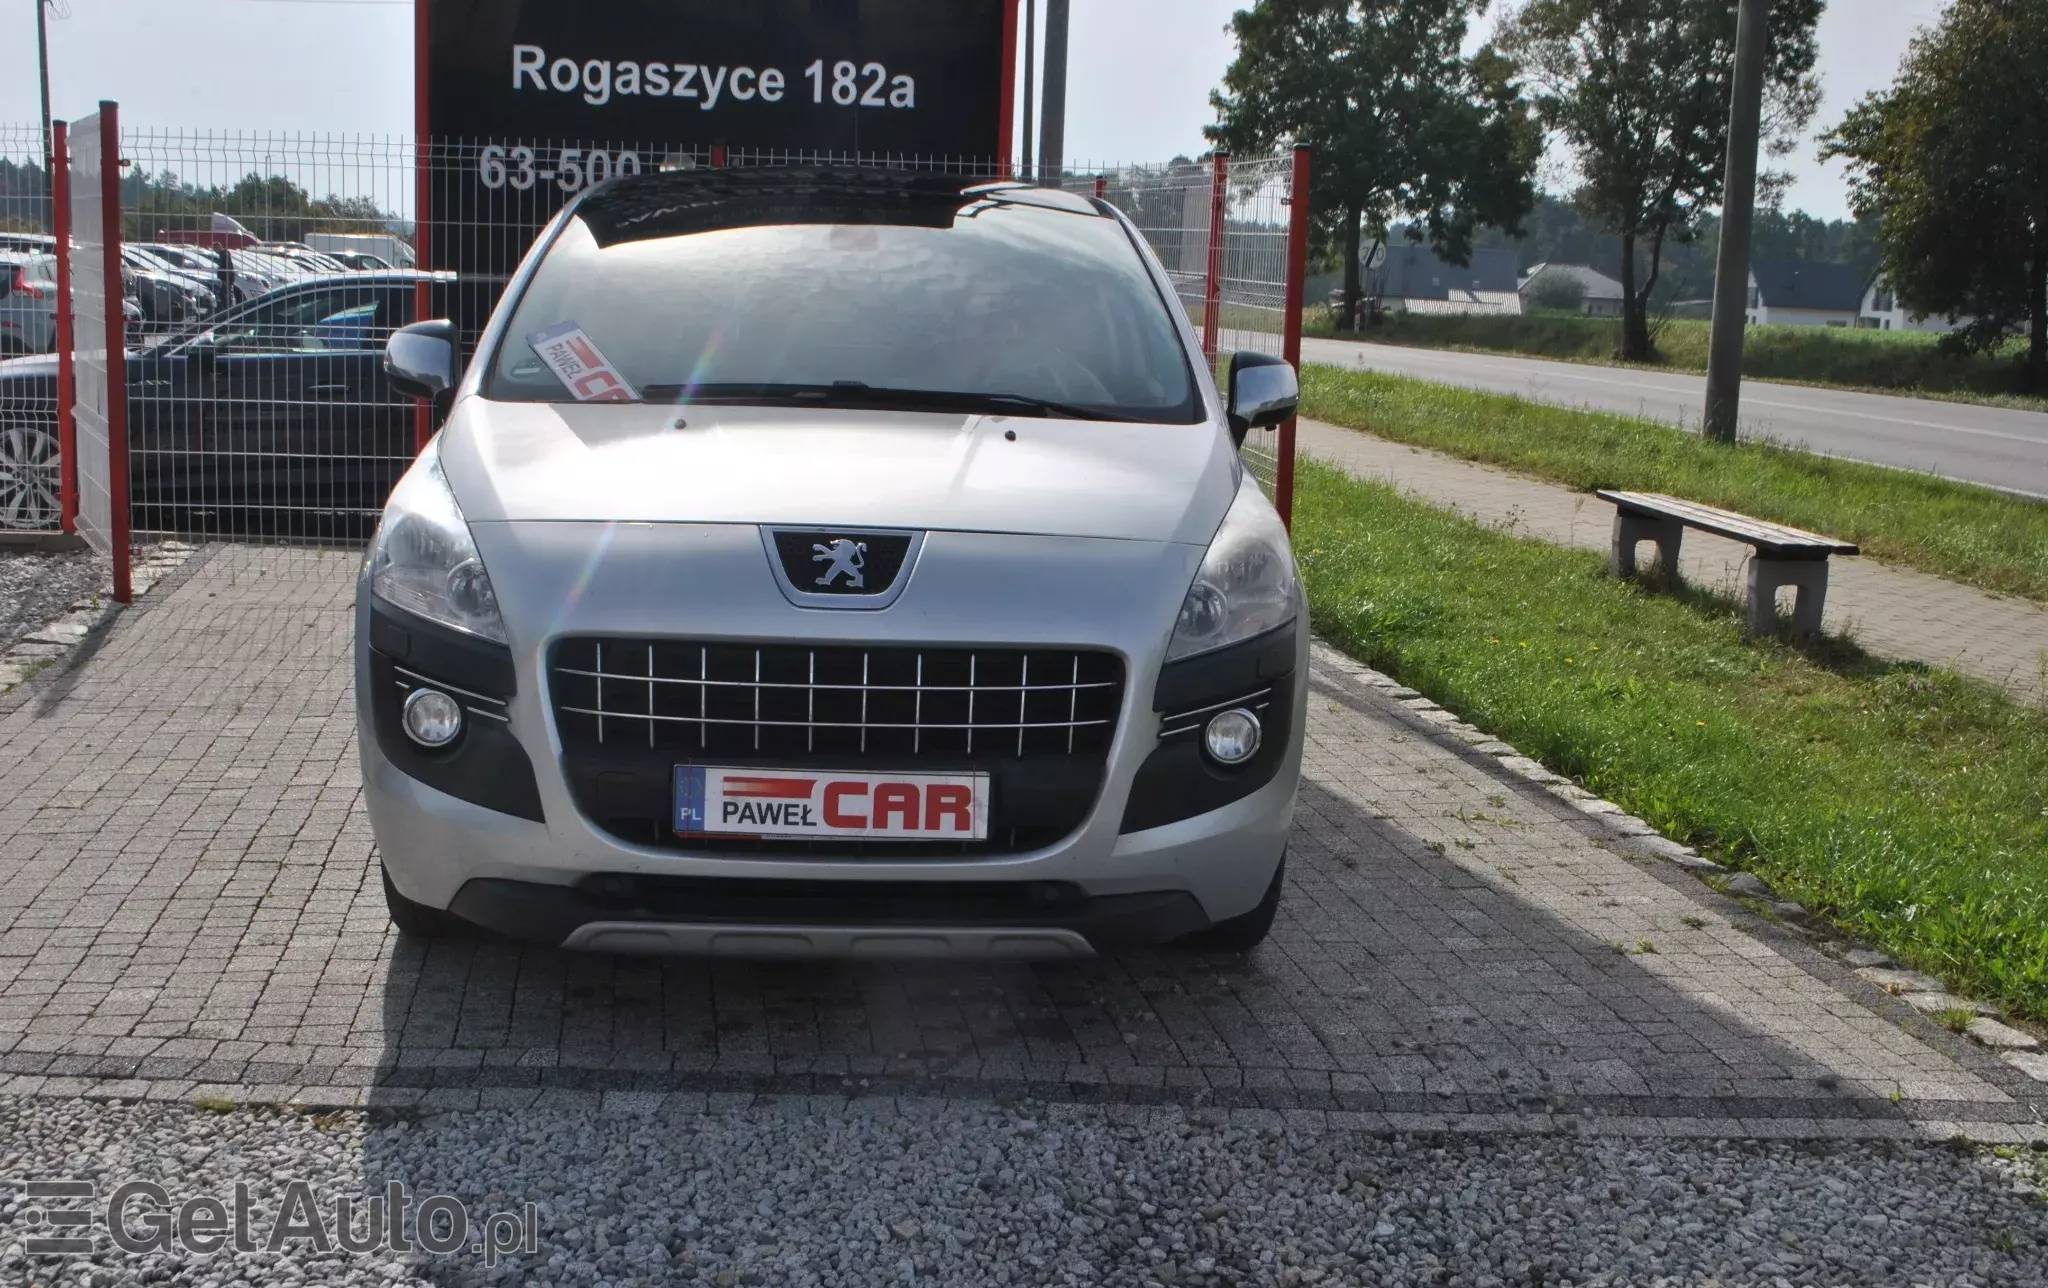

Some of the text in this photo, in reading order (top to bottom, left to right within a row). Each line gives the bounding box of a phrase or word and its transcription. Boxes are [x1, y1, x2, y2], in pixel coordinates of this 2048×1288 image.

[512, 44, 915, 110] Rogaszyce 182a
[479, 144, 641, 192] 63-500
[1362, 247, 1384, 261] 70
[545, 342, 584, 379] PAWEŁ
[680, 807, 702, 821] PL
[722, 781, 972, 831] PAWEŁ CAR
